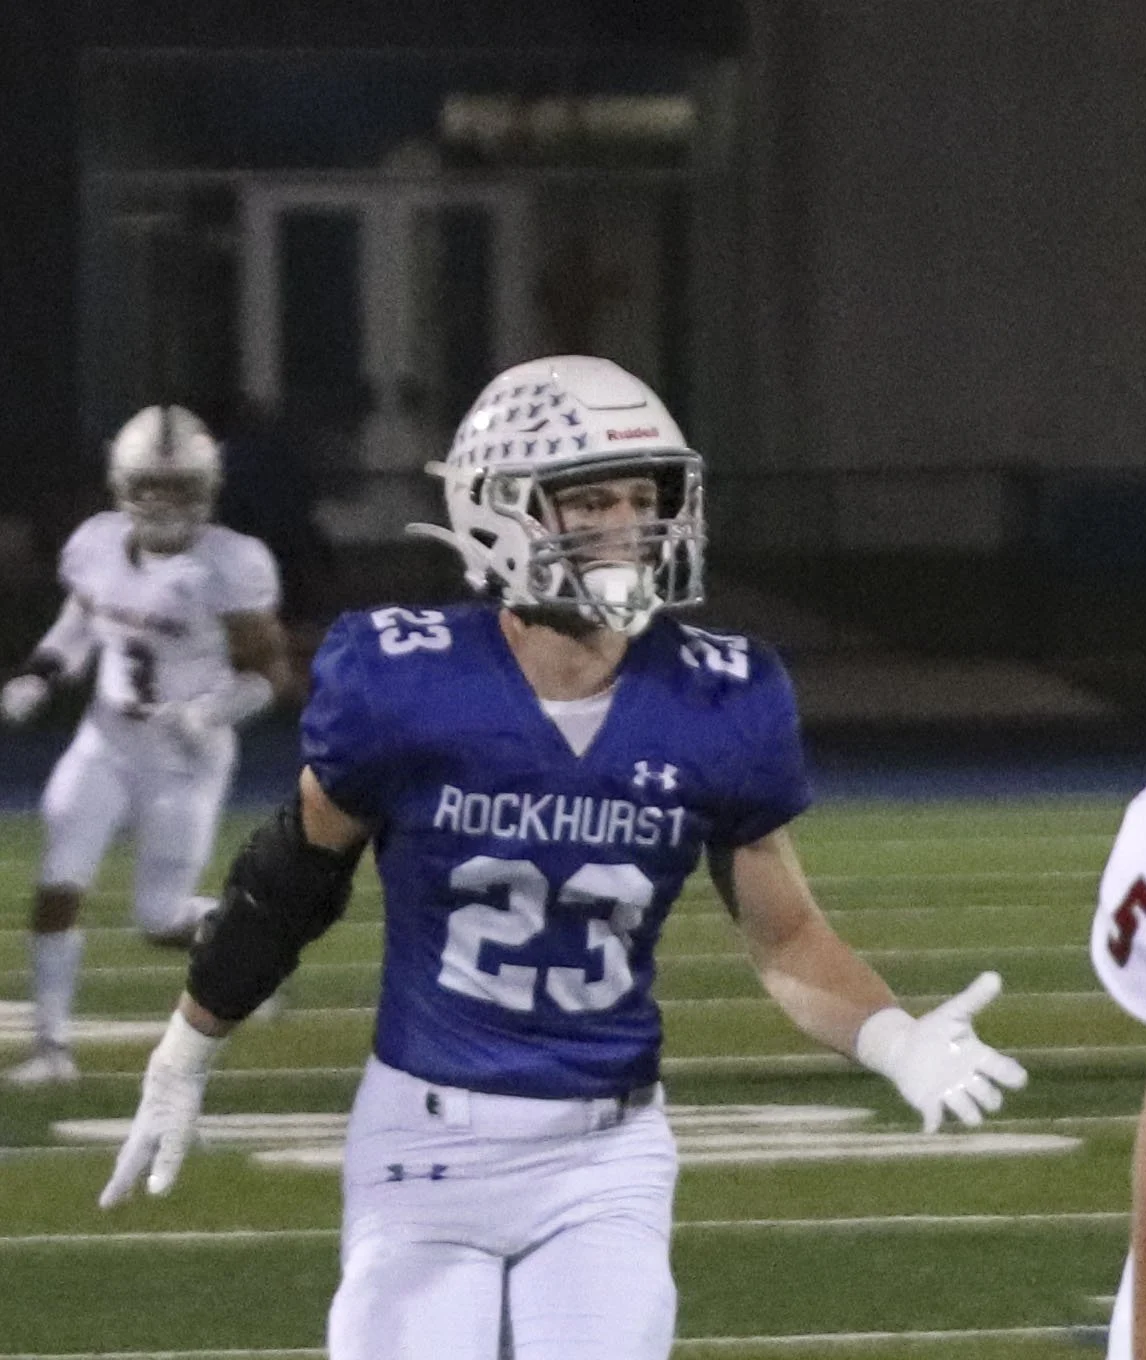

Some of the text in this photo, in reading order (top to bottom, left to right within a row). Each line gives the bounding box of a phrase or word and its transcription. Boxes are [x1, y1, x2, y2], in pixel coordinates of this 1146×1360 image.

[371, 606, 452, 656] 23
[433, 784, 686, 846] ROCKHURST
[437, 854, 655, 1012] 23
